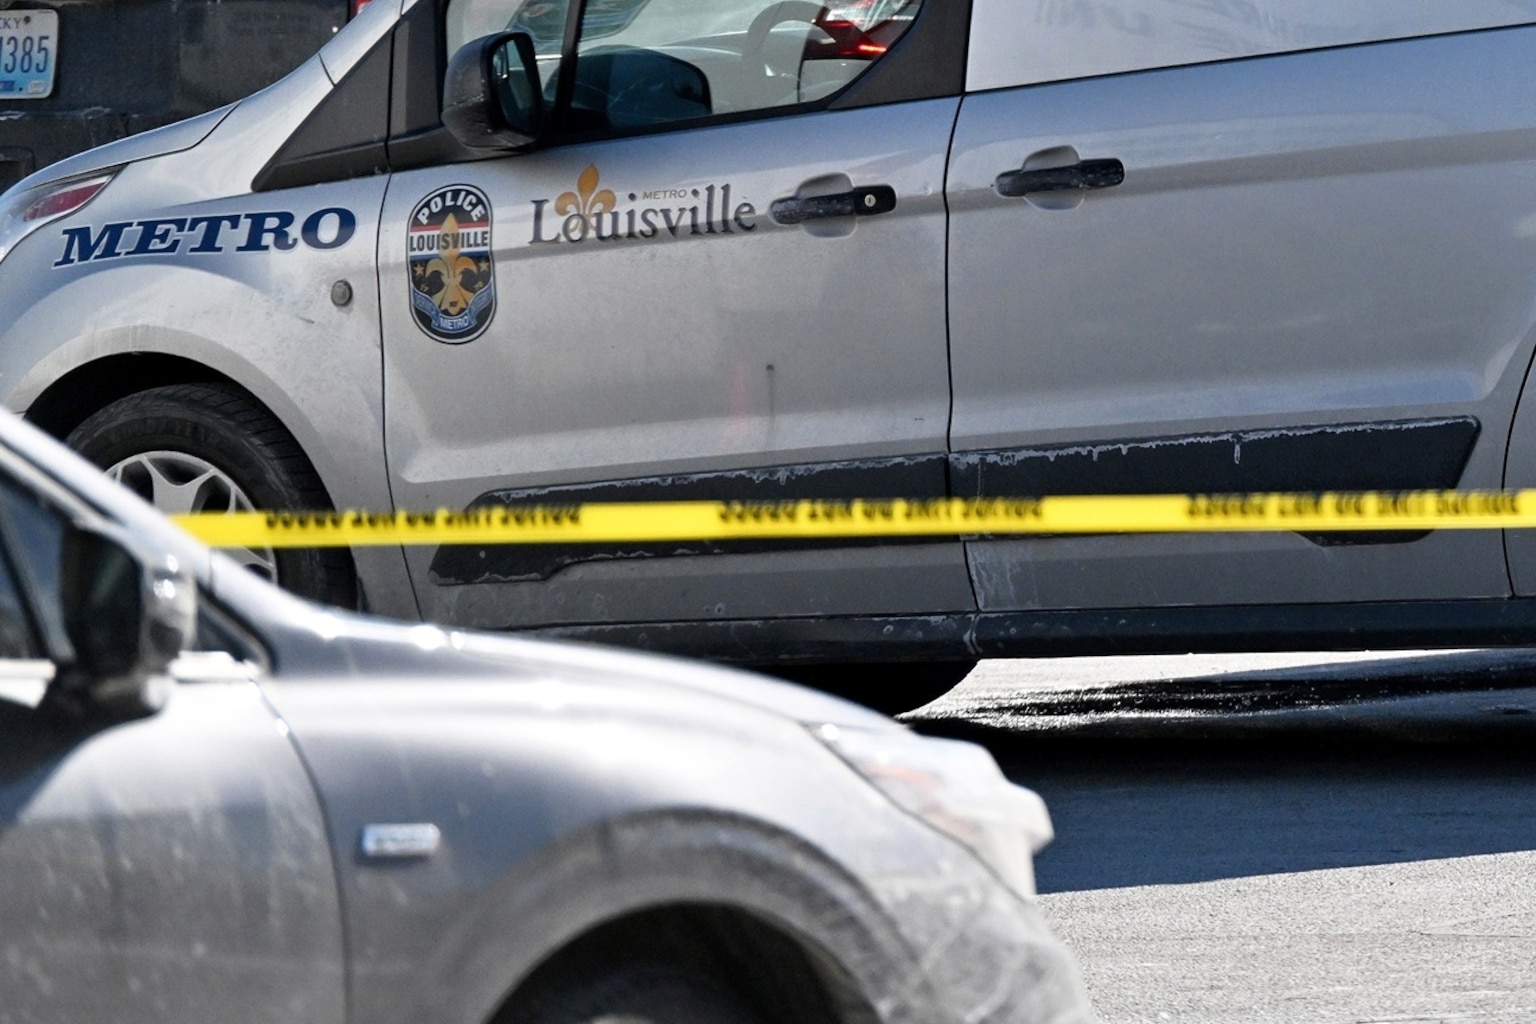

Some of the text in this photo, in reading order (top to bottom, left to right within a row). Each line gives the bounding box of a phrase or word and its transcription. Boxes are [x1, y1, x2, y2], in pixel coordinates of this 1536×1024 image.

[417, 191, 486, 225] POLICE
[642, 189, 688, 200] METRO
[528, 183, 756, 244] Louisville
[53, 207, 357, 268] METRO
[409, 231, 489, 252] LOUISVILLE
[440, 316, 469, 329] METRO
